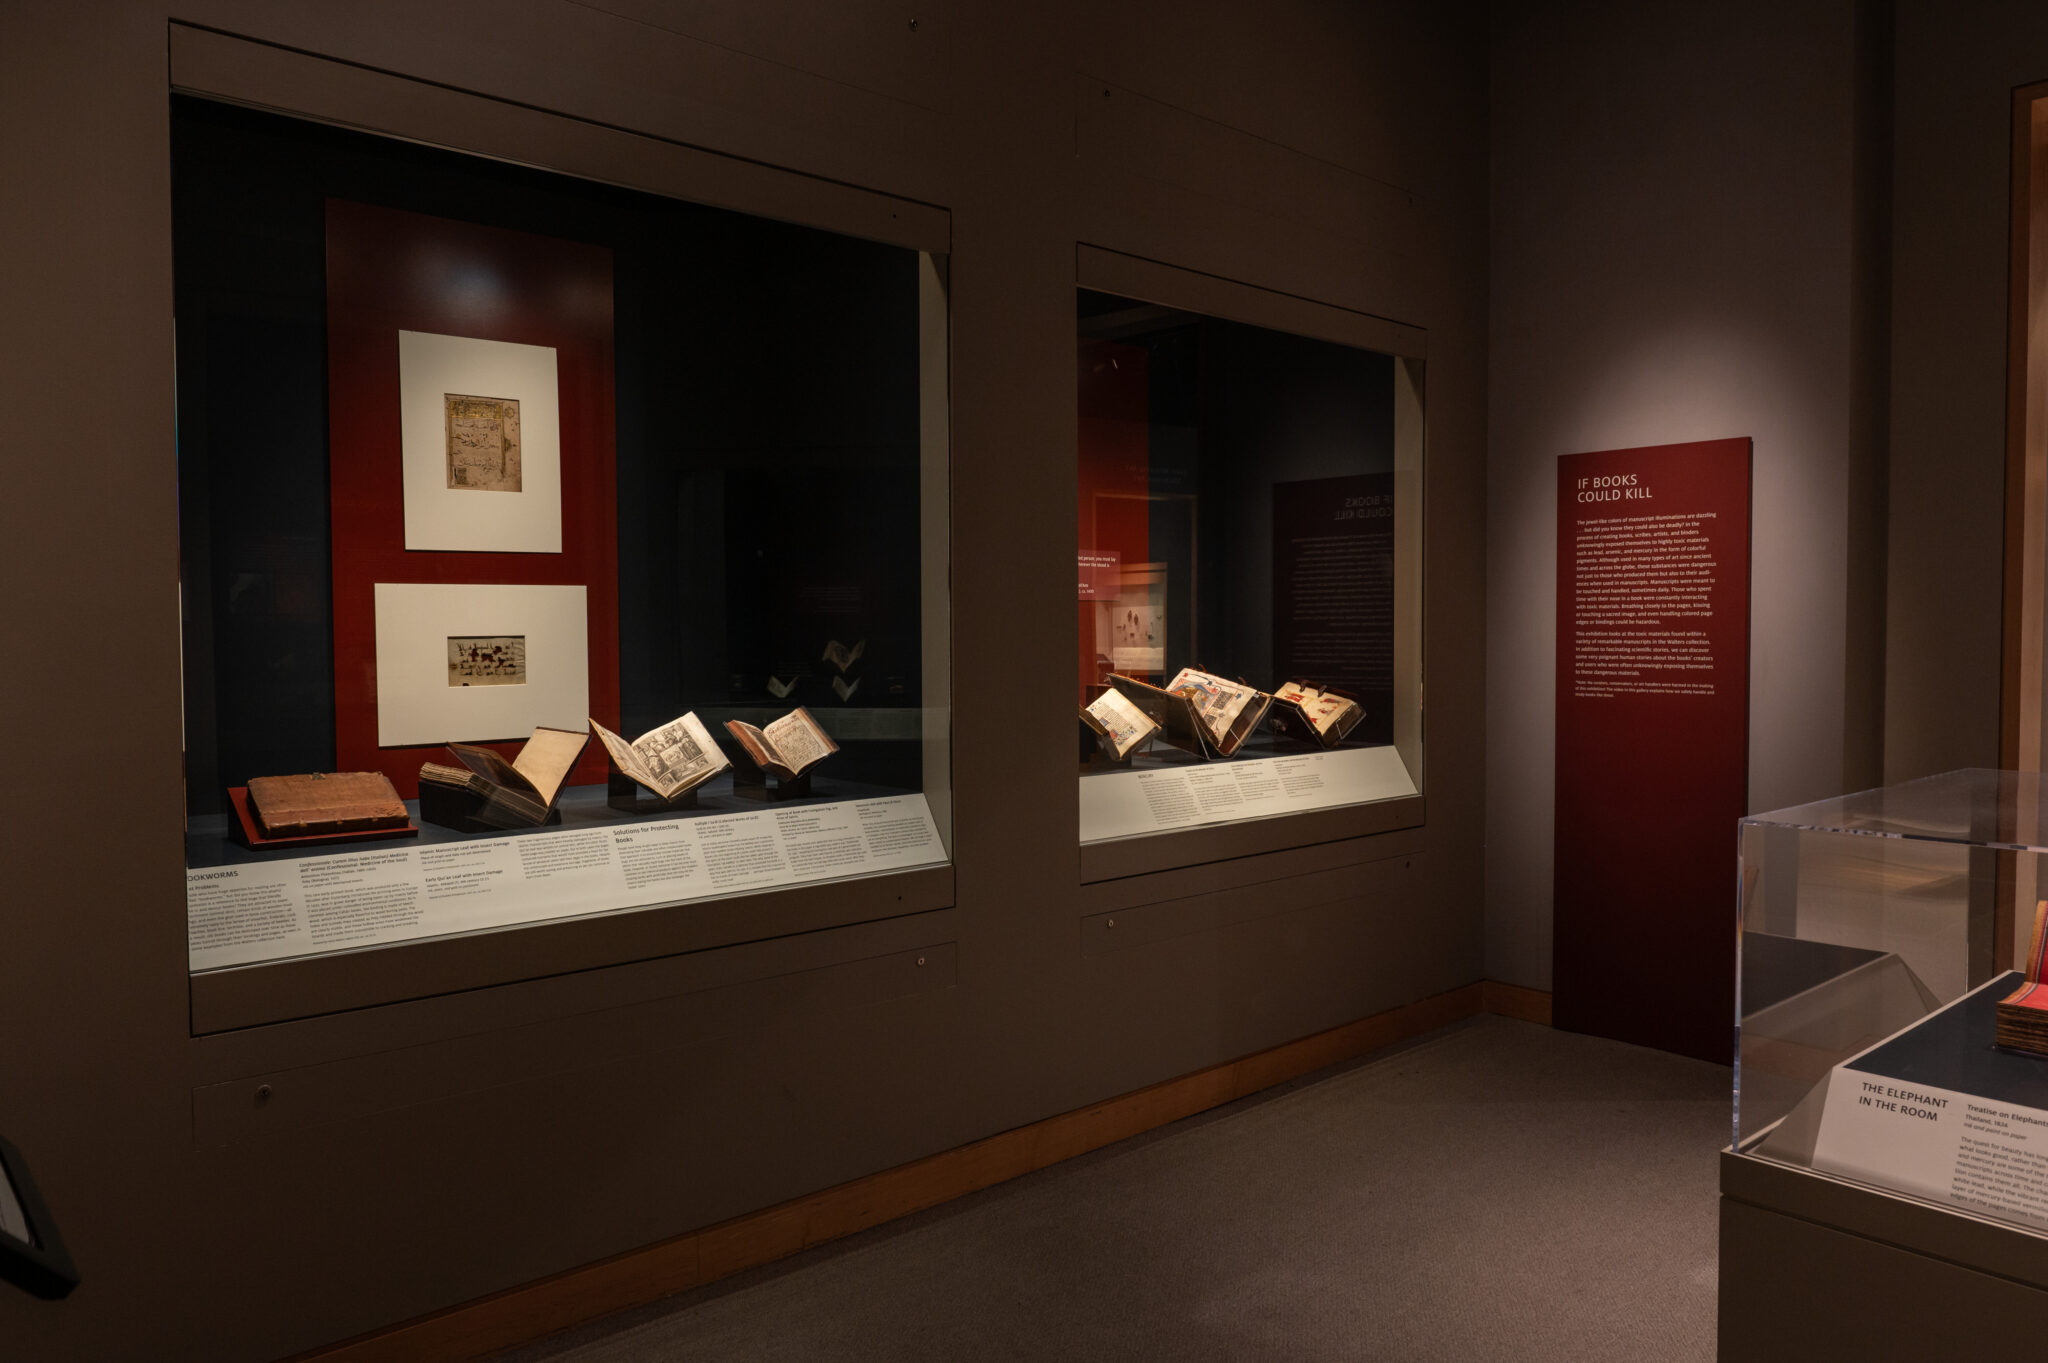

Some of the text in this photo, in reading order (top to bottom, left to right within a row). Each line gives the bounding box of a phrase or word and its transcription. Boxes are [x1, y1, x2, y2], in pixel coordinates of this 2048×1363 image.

[1578, 474, 1637, 489] IF BOOKS
[1578, 487, 1652, 502] COULD KILL
[650, 823, 679, 832] Protecting
[188, 870, 239, 881] OOKWORMS
[1862, 1082, 1949, 1109] THE ELEPHANT
[1859, 1095, 1938, 1121] IN THE ROOM
[1966, 1114, 1992, 1125] Thailand,
[1968, 1104, 1998, 1116] Treatise
[2011, 1114, 2048, 1127] Elephants
[2002, 1146, 2022, 1156] beauty
[1971, 1156, 1995, 1166] mercury
[1956, 1161, 1992, 1173] manuscripts
[1968, 1172, 1993, 1182] contains
